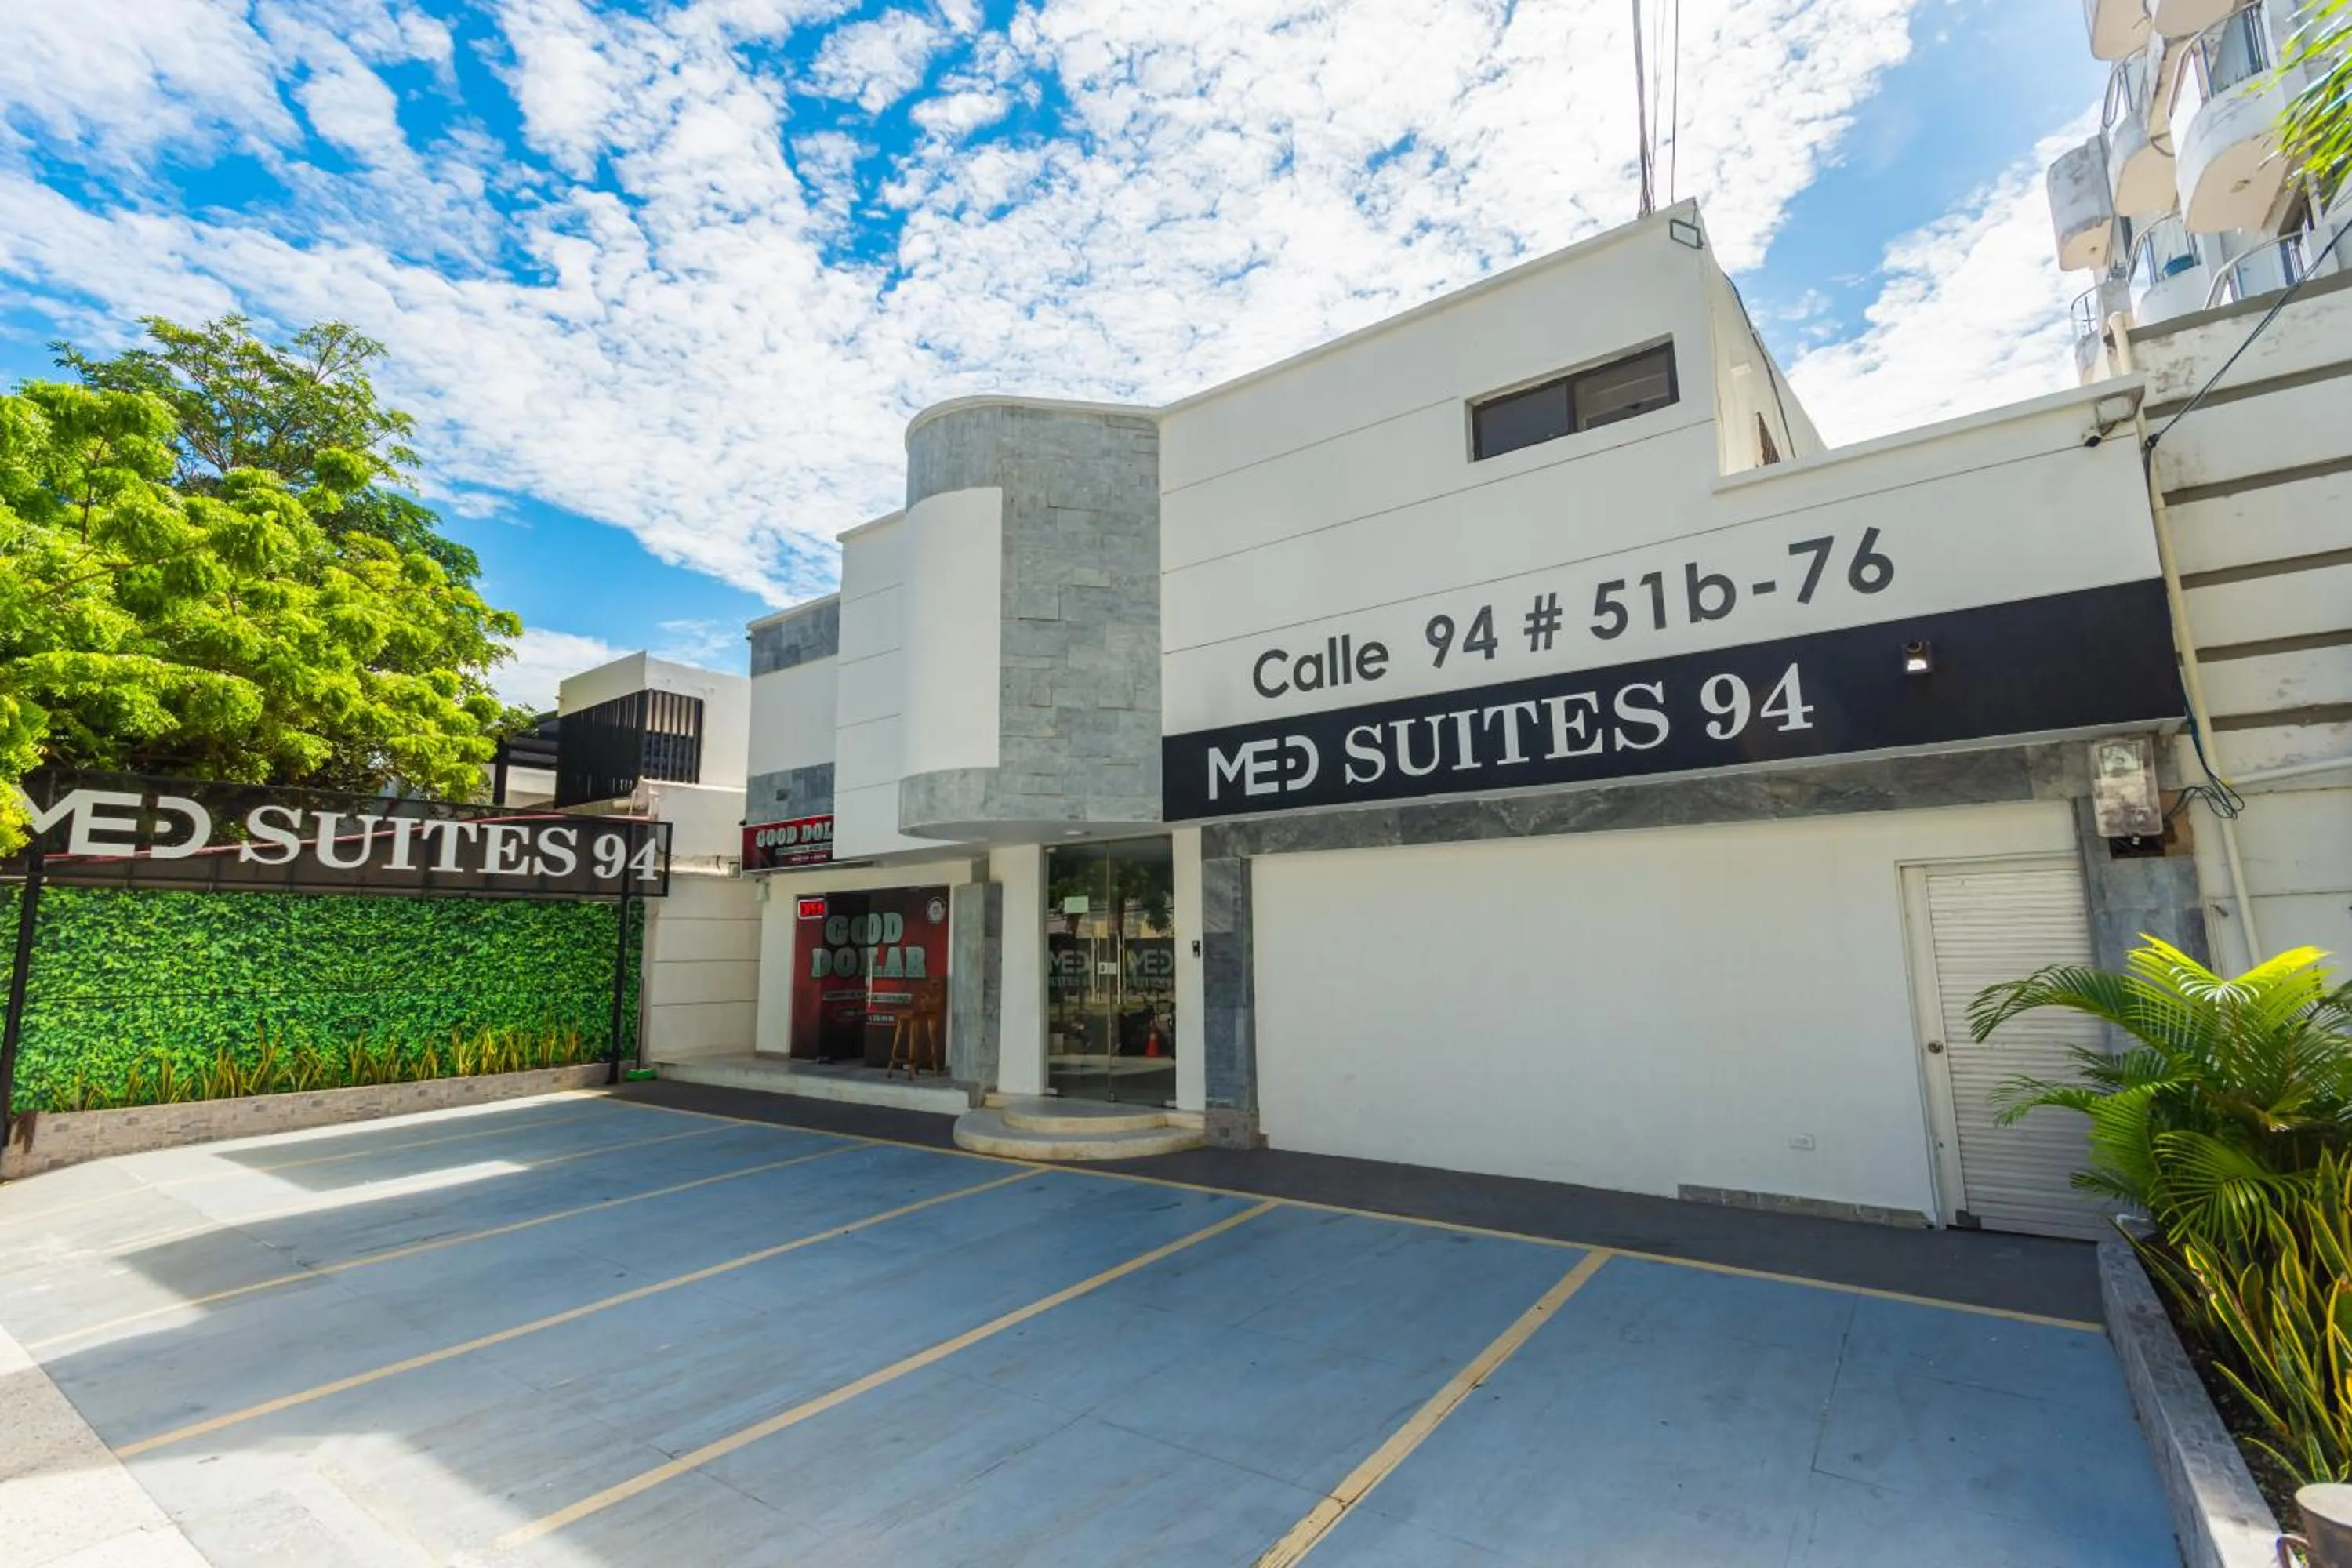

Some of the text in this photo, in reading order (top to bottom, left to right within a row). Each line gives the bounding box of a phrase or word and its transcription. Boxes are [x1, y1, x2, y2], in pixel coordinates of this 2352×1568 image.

[1253, 527, 1895, 699] Calle 94 # 51b-76
[1208, 662, 1814, 800] MED SUITES 94
[239, 805, 579, 878] SUITES
[593, 833, 659, 881] 94
[756, 826, 797, 847] GOOD
[826, 913, 904, 946] GOOD
[811, 946, 926, 978] DOLLAR
